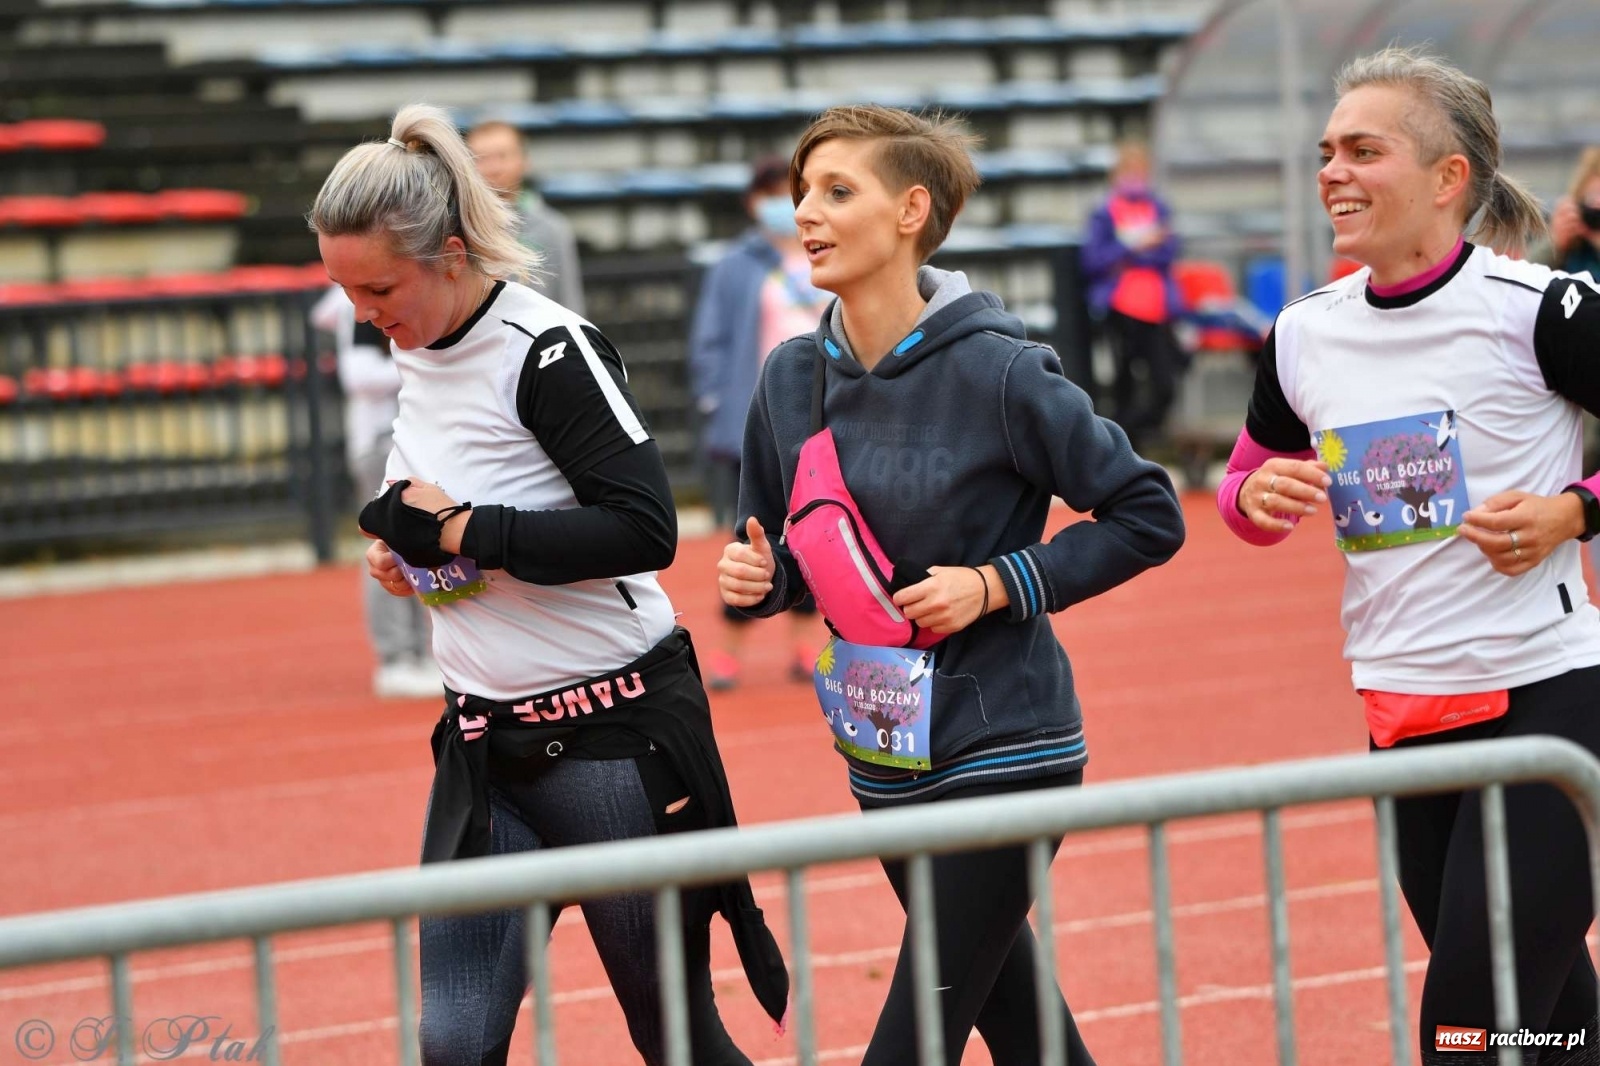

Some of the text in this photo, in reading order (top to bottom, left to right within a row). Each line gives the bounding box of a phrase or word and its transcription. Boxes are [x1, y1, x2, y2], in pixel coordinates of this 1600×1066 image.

[1337, 457, 1452, 487] BIEG DLA BOŻENY
[1401, 498, 1455, 526] 047
[427, 564, 467, 592] 284
[825, 677, 921, 707] BIEG DLA BOŻENY
[876, 728, 915, 753] 031
